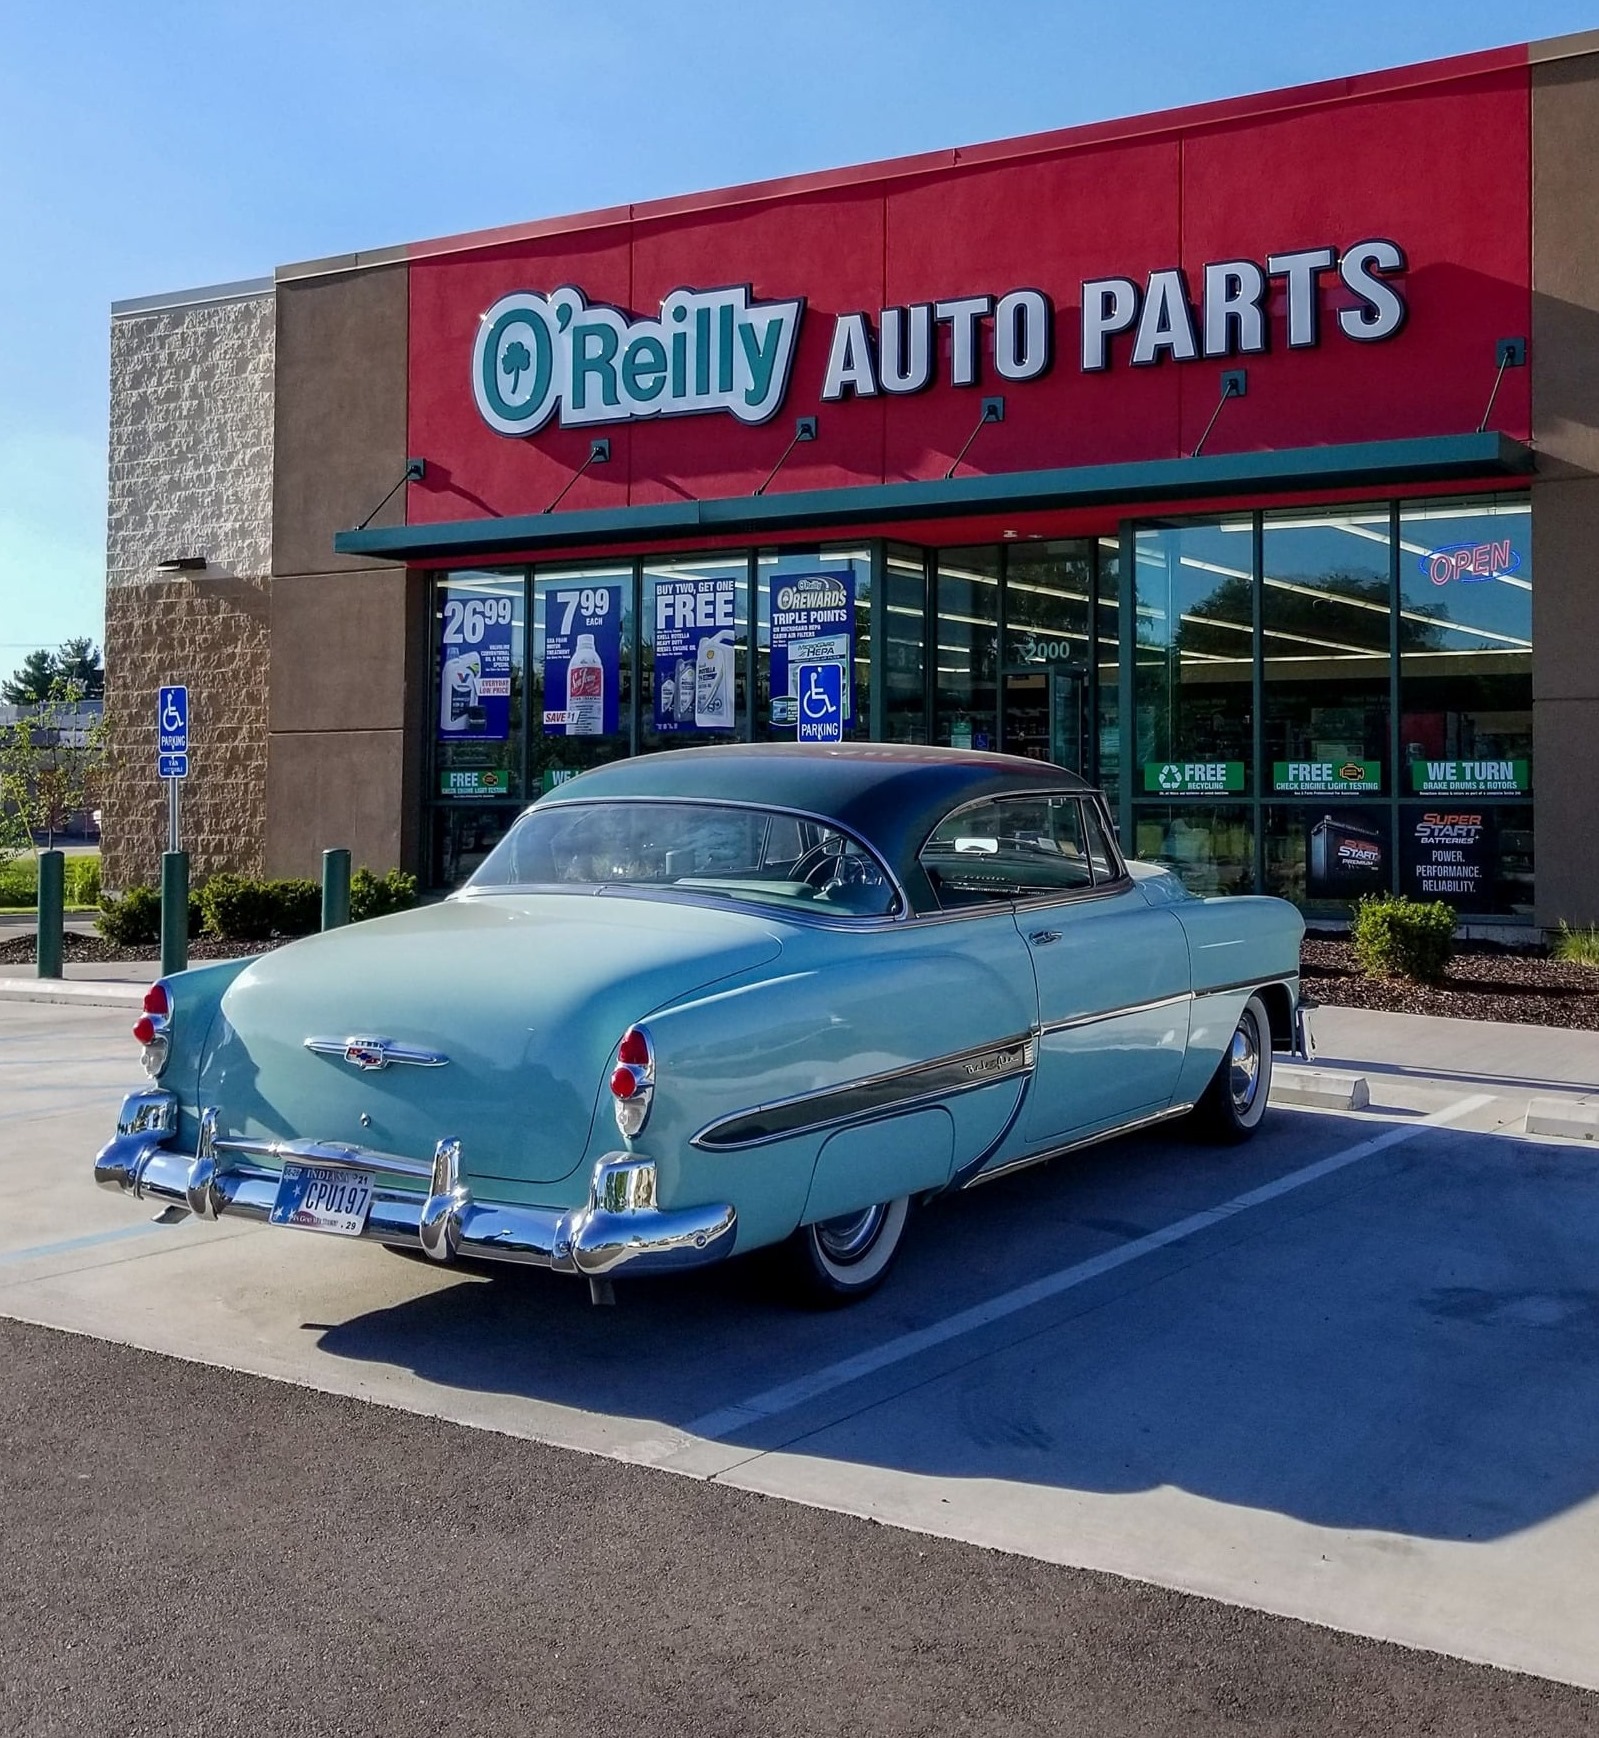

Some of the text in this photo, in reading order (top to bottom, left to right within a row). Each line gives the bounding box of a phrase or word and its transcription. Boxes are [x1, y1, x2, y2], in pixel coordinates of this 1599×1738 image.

[480, 239, 1405, 423] O'Reilly AUTO PARTS
[1430, 540, 1510, 586] OPEN
[656, 580, 734, 595] BUY TWO, GET ONE
[657, 592, 734, 629] FREE
[772, 609, 847, 625] TRIPLE POINTS
[586, 617, 603, 626] EACH
[807, 647, 835, 657] HEPA
[1024, 641, 1070, 660] 2000
[545, 712, 576, 723] SAVE $1
[801, 722, 839, 737] PARKING
[161, 735, 186, 747] PARKING
[1184, 764, 1227, 782] FREE
[1288, 763, 1333, 781] FREE
[1427, 761, 1514, 780] WE TURN
[450, 771, 479, 787] FREE
[1187, 782, 1224, 790] RECYCLING
[1276, 782, 1379, 790] CHECK ENGINE LIGHT TESTING
[1423, 781, 1518, 790] BRAKE DRUMS & ROTORS
[1423, 813, 1482, 825] SUPER
[1414, 823, 1483, 837] START
[1338, 846, 1379, 860] START
[1432, 850, 1465, 862] POWER.
[1416, 865, 1482, 878] PERFORMANCE.
[1422, 880, 1476, 893] RELIABILITY.
[307, 1169, 349, 1183] INDIANA
[305, 1182, 369, 1216] CPU197
